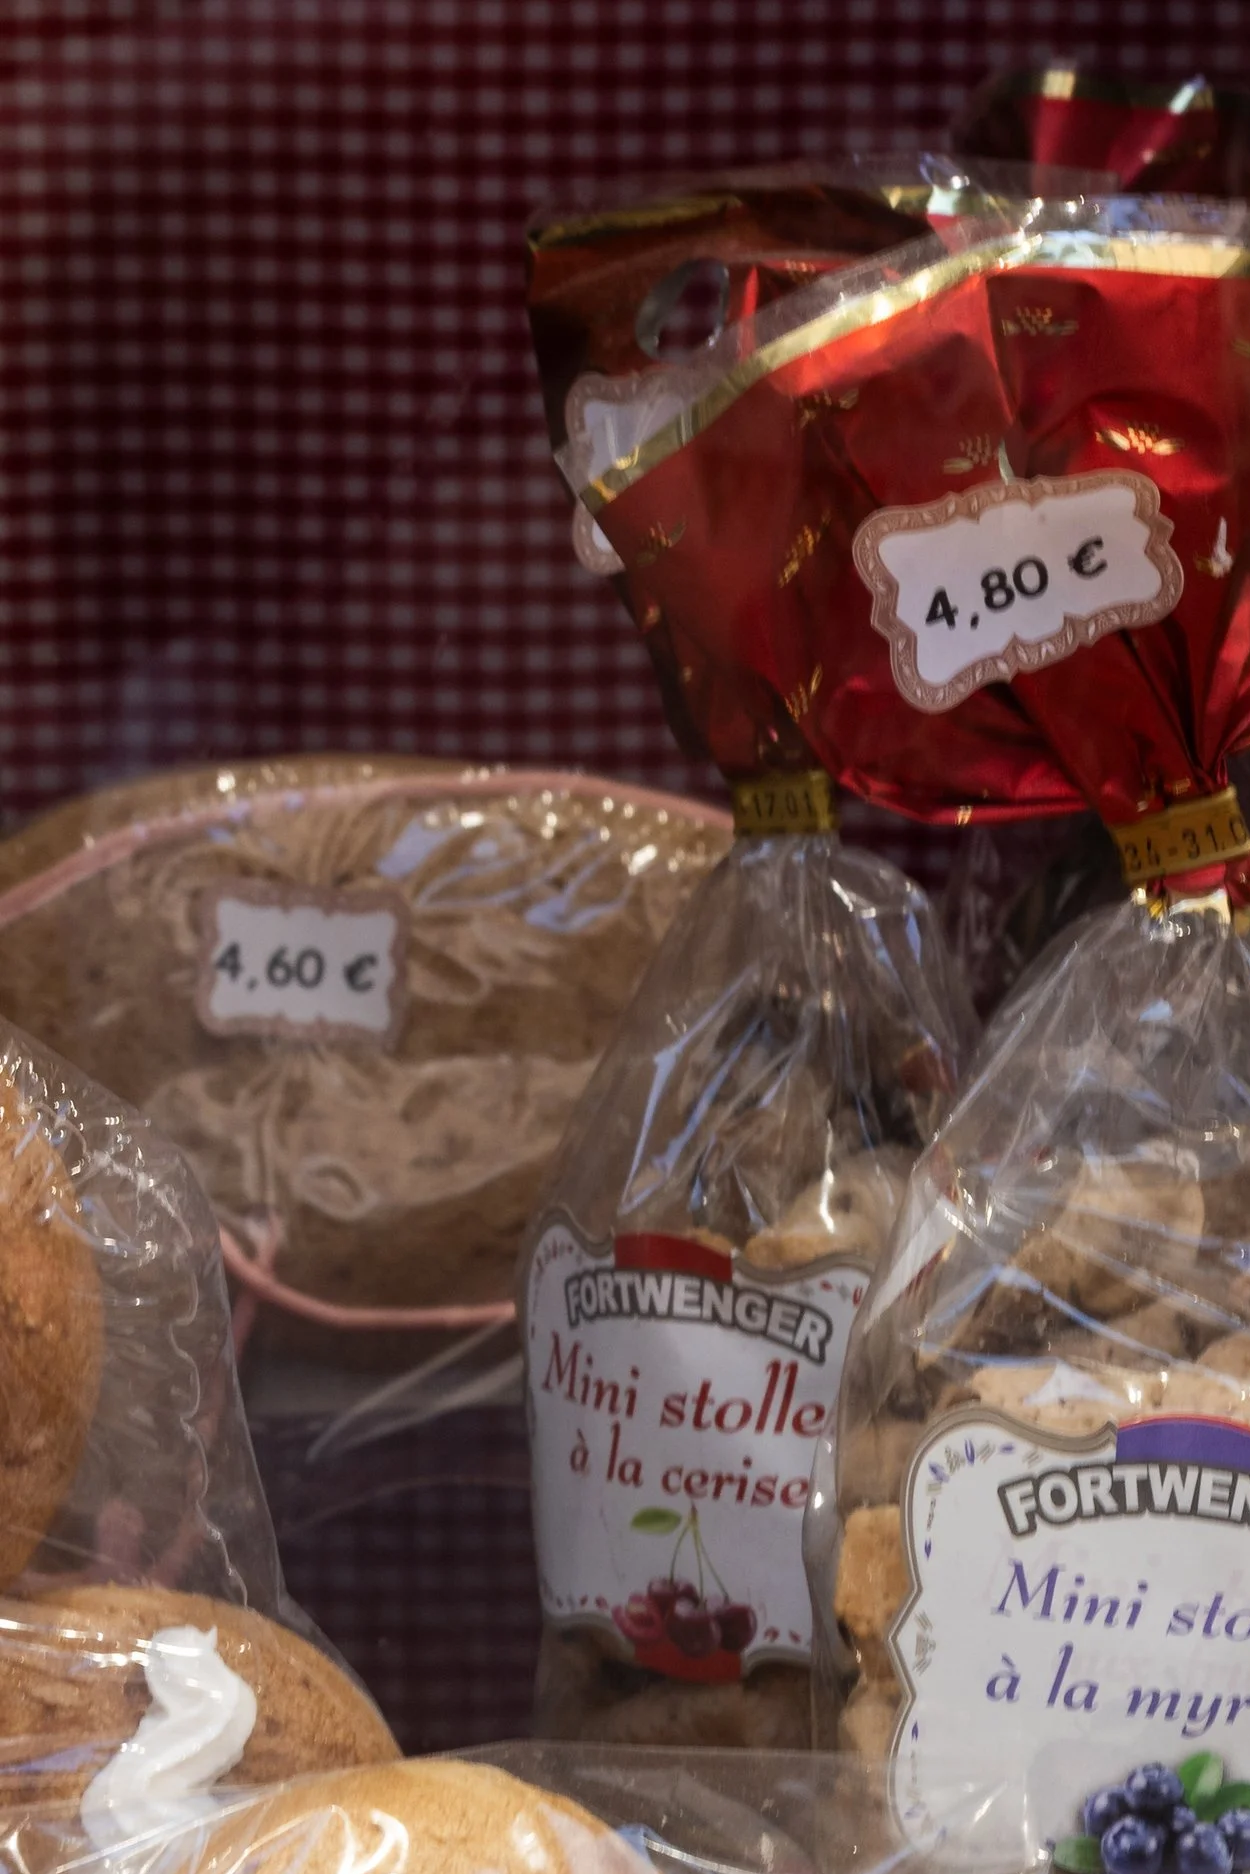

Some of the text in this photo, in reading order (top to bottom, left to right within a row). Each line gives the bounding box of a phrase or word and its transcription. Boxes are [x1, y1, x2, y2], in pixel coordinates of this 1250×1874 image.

[925, 535, 1108, 629] 4,80 €
[215, 941, 378, 993] 4,60 €
[565, 1268, 833, 1366] FORTWENGER
[542, 1331, 827, 1438] Mini stolle
[569, 1420, 811, 1510] à la cerise
[991, 1559, 1149, 1630] Mini
[985, 1655, 1019, 1703] à
[1046, 1641, 1099, 1714] la
